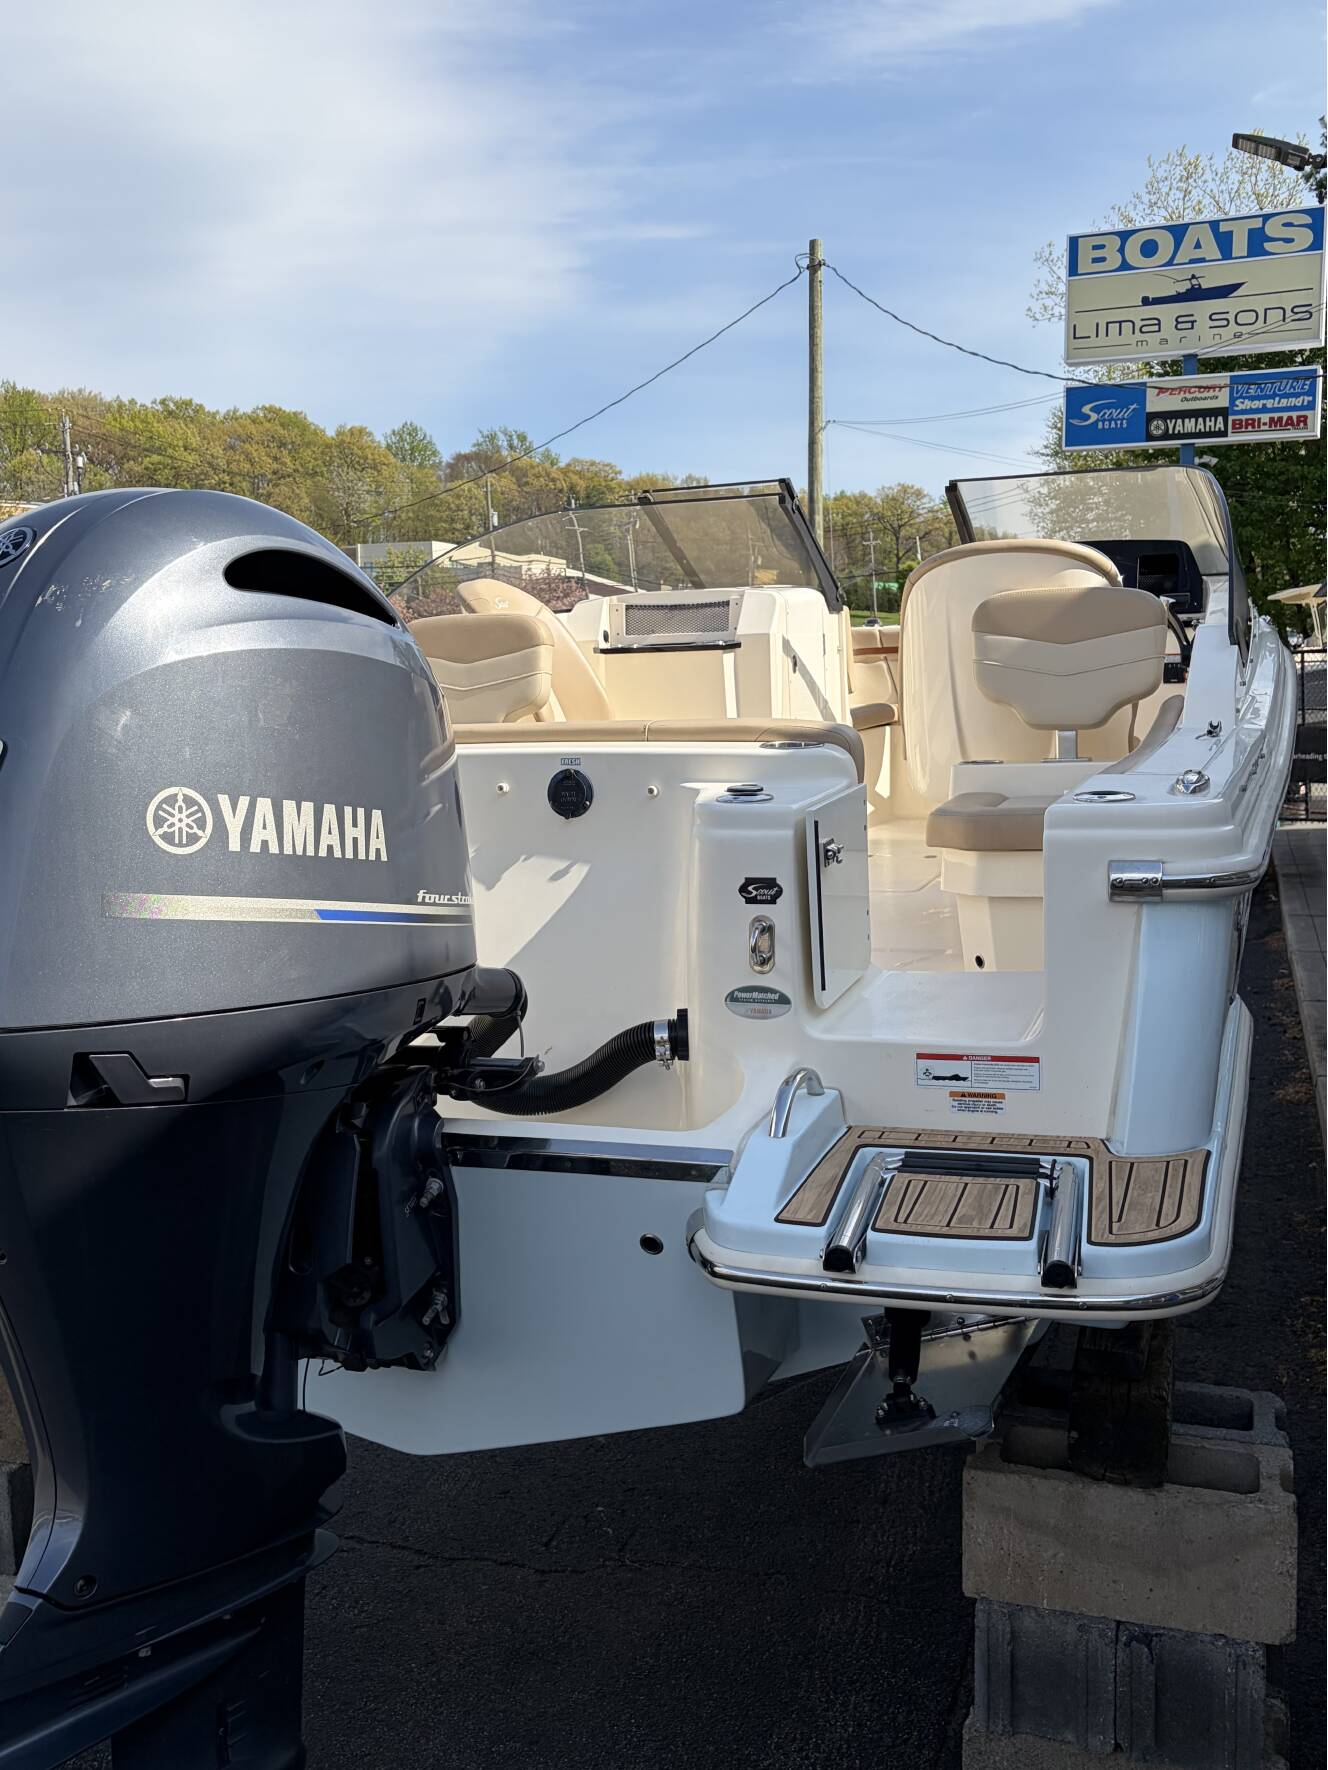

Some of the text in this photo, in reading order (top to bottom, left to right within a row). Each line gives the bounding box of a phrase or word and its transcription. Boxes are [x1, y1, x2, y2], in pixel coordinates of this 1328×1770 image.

[1077, 213, 1314, 274] BOATS
[1174, 313, 1197, 331] &
[1136, 331, 1243, 348] marine
[1233, 379, 1312, 397] VENTURE
[1180, 394, 1219, 403] Outboards
[1069, 399, 1140, 426] Scout
[1098, 420, 1127, 429] BOATS
[1167, 416, 1225, 434] YAMAHA
[1231, 415, 1309, 431] BRI-MAR
[217, 794, 388, 862] YAMAHA
[740, 884, 781, 897] Scout
